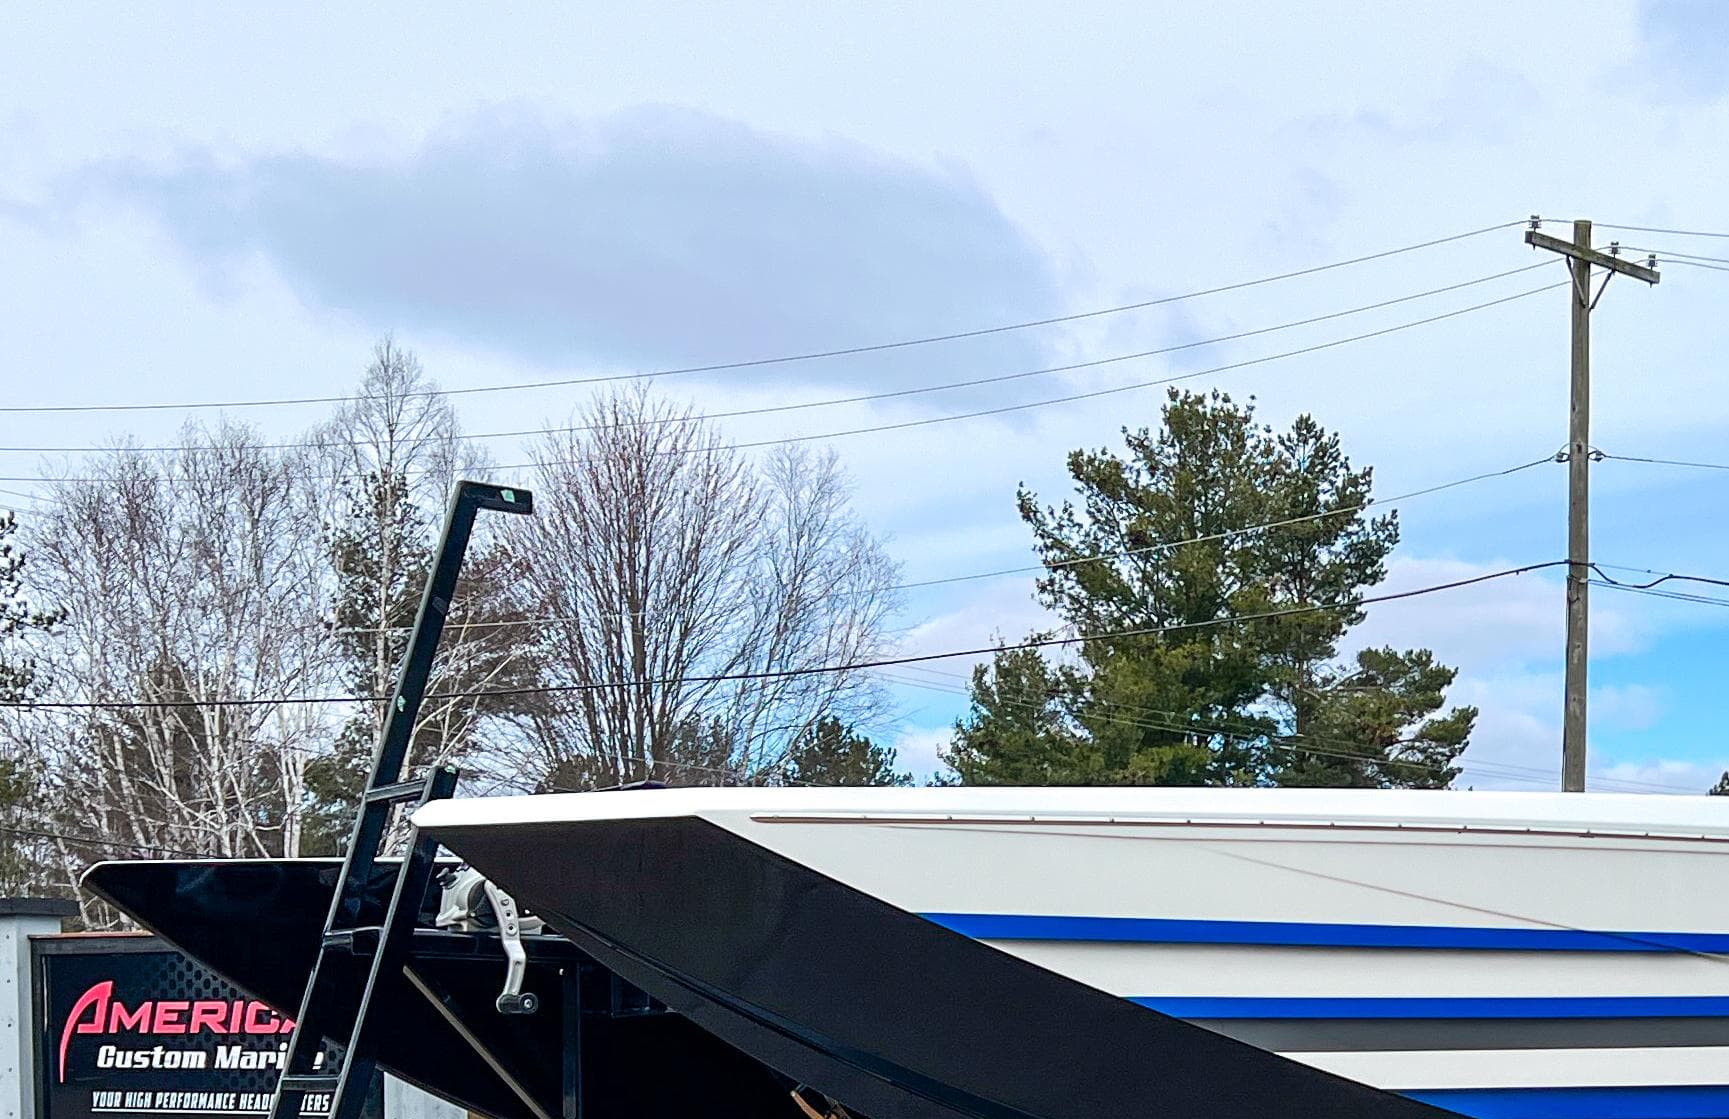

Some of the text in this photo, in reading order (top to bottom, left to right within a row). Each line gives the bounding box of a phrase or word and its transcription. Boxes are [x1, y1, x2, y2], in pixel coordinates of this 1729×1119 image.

[60, 980, 297, 1083] AMERIC
[97, 1045, 206, 1069] Custom
[93, 1091, 122, 1107] YOUR
[125, 1091, 152, 1108] HIGH
[155, 1092, 235, 1109] PERFORMANCE
